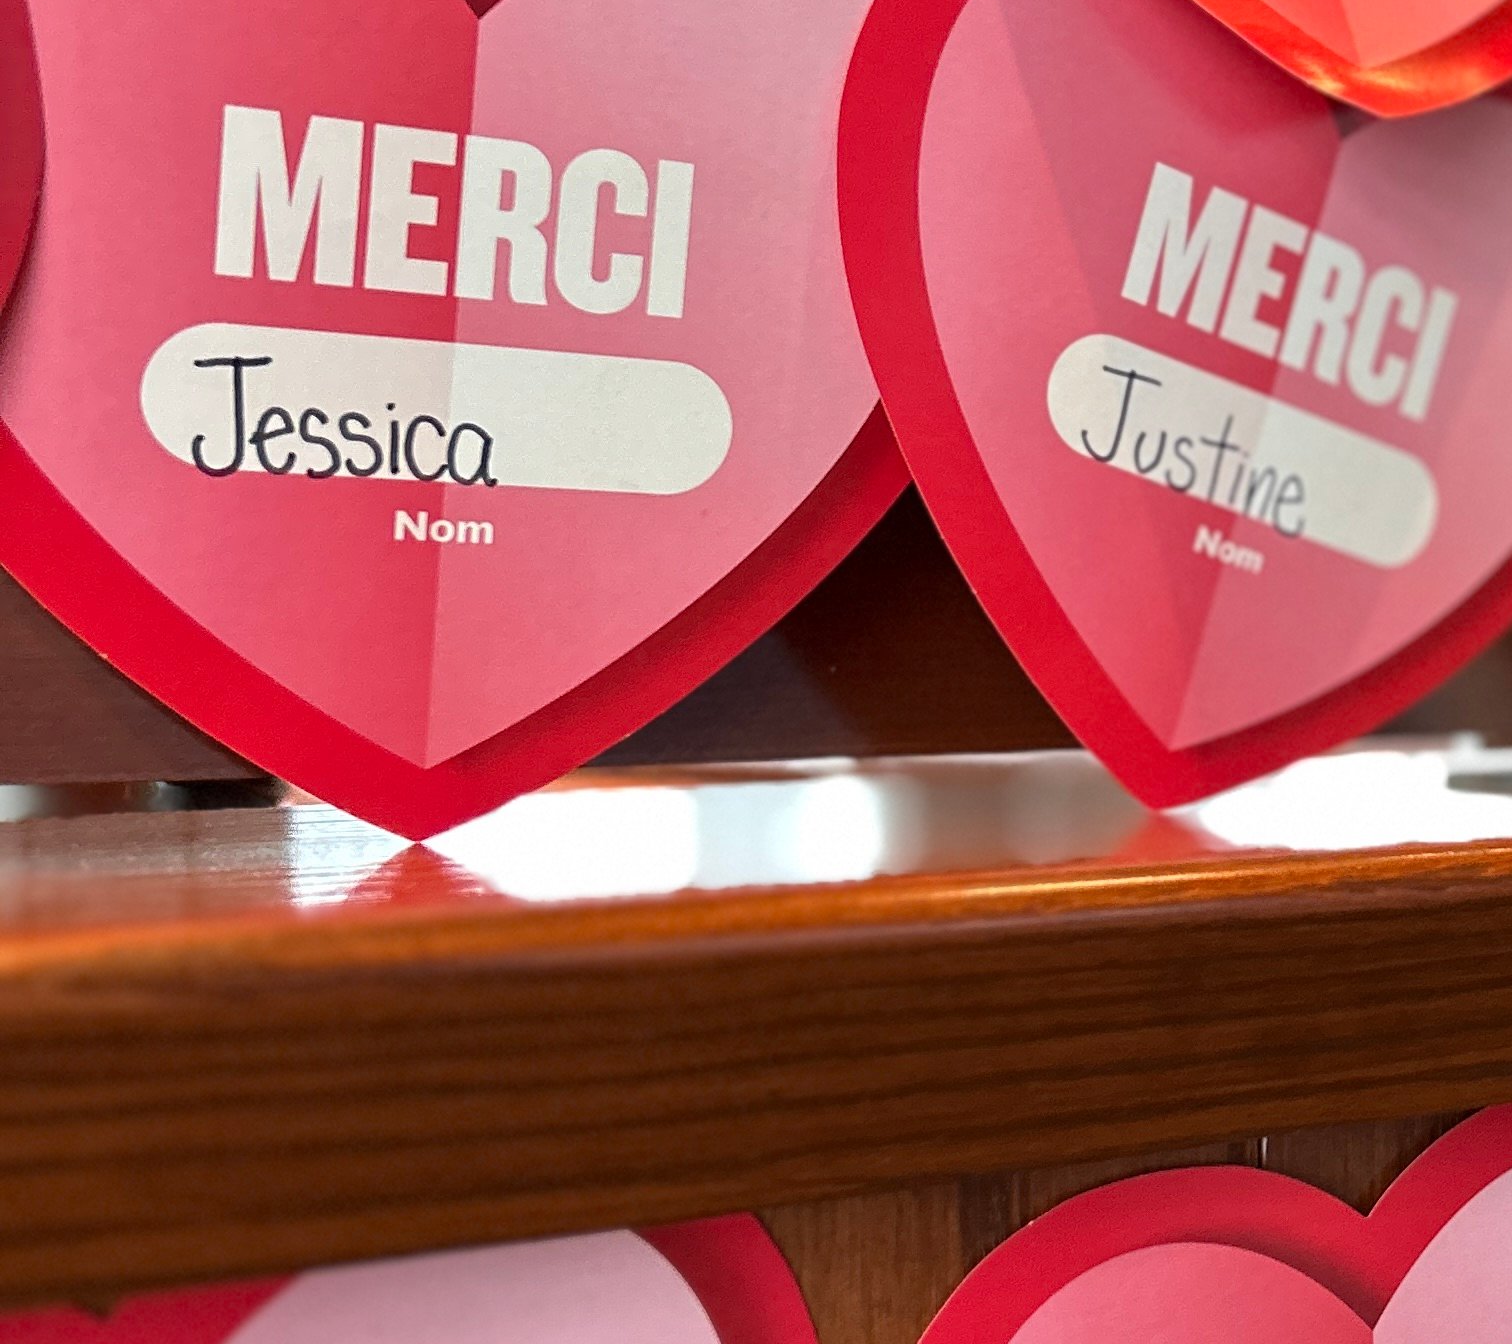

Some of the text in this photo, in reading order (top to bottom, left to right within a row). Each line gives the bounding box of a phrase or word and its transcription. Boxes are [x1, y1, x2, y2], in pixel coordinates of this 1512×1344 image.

[213, 104, 696, 318] MERCI
[1120, 161, 1458, 423] MERCI
[191, 355, 499, 488] Jessica
[1080, 364, 1307, 538] Justine
[393, 509, 495, 546] Nom
[1192, 525, 1265, 575] Nom
